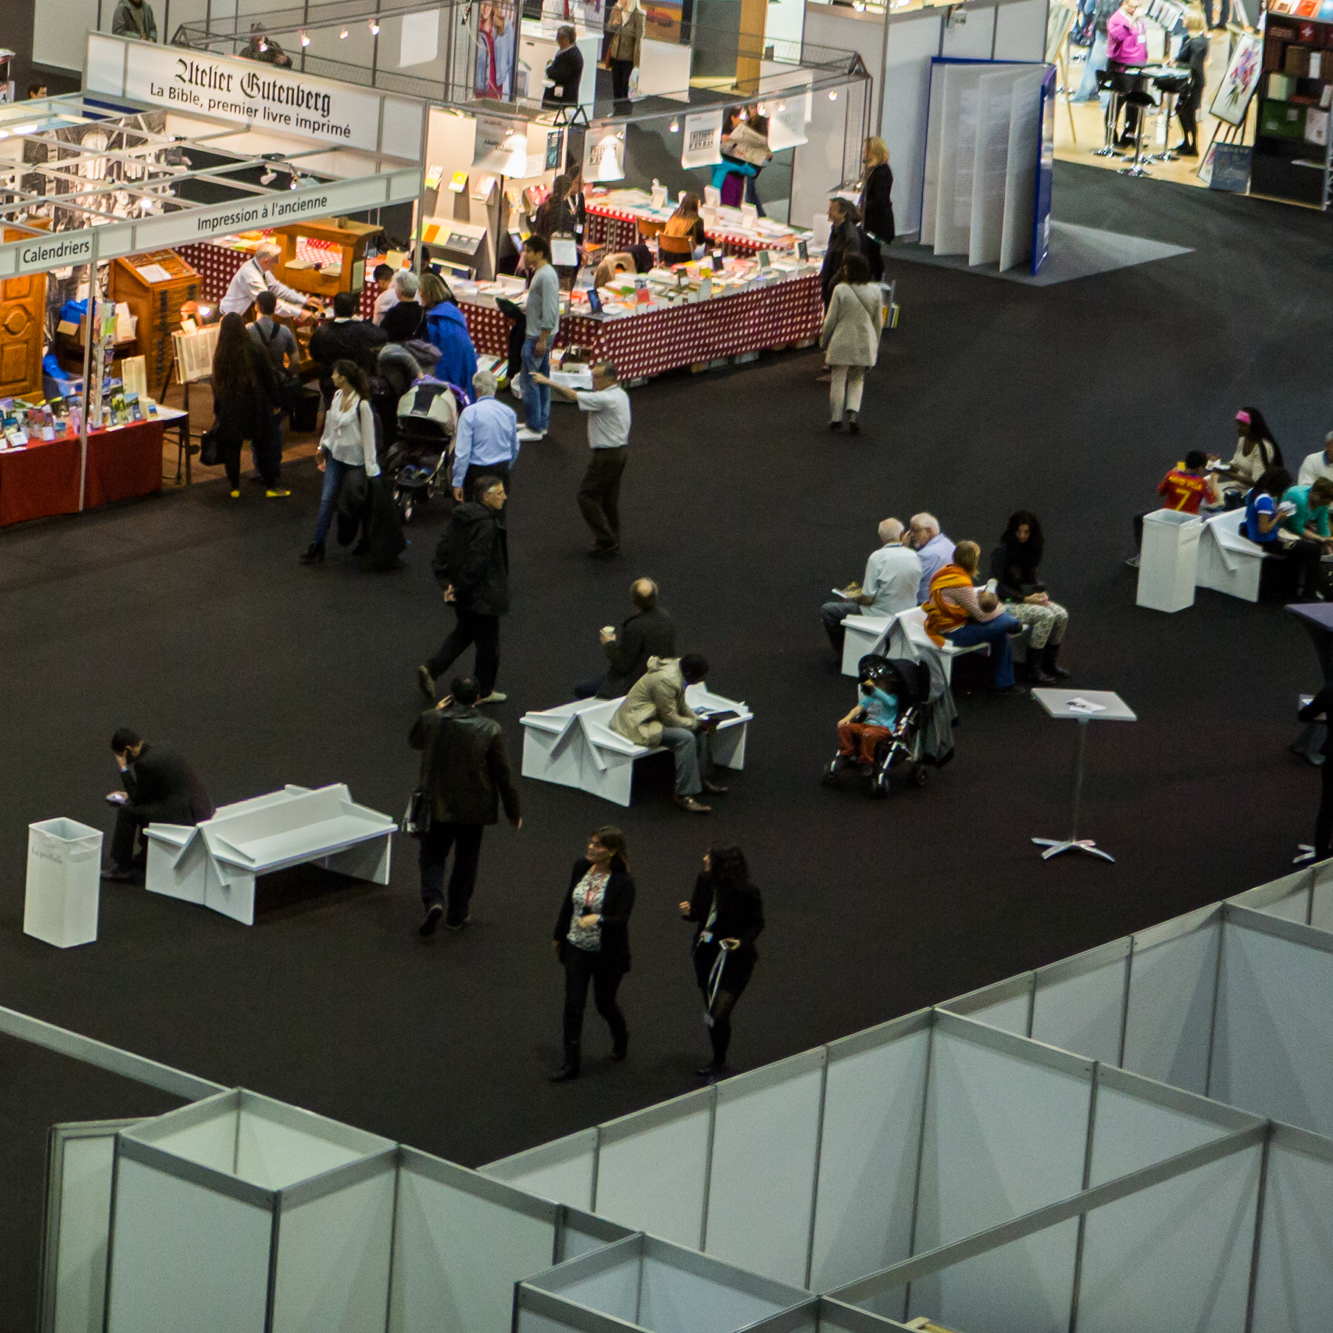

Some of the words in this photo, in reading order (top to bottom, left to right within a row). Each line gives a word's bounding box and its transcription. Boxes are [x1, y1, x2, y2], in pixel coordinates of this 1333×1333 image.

[175, 58, 234, 94] Atelier
[239, 71, 332, 119] Gutenberg
[150, 82, 166, 98] La
[168, 85, 205, 113] Bible,
[208, 97, 259, 124] premier
[262, 104, 293, 126] livre
[296, 111, 351, 142] imprimé
[197, 207, 259, 234] Impression
[261, 205, 269, 219] à
[271, 195, 328, 217] l'ancienne
[23, 238, 90, 264] Calendriers
[1176, 488, 1191, 512] 7
